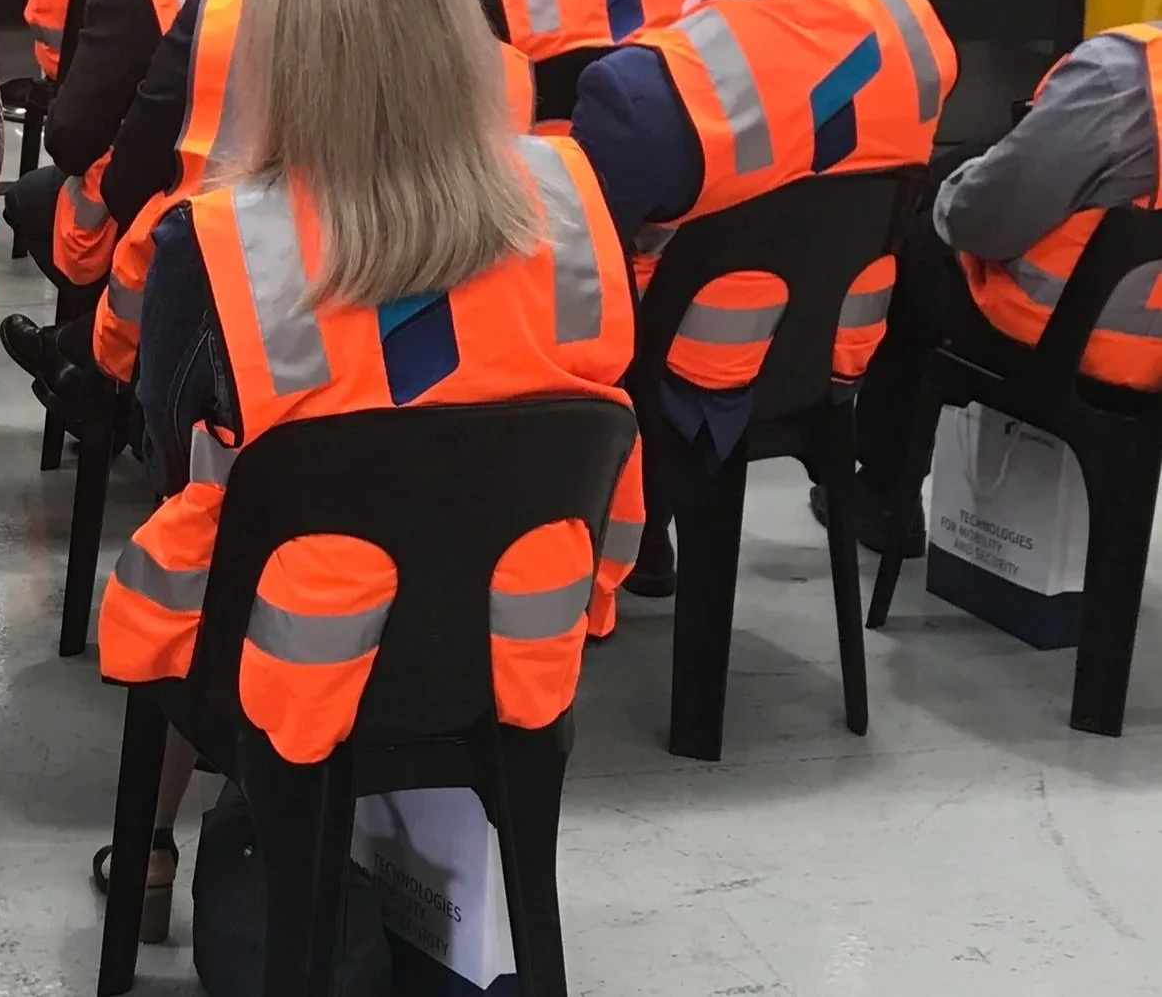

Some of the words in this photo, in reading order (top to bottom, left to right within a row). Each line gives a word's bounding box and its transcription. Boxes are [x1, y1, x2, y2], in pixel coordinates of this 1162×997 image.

[940, 516, 957, 531] FOR
[959, 509, 1034, 550] TECHNOLOGIES
[373, 852, 462, 923] TECHNOLOGIES
